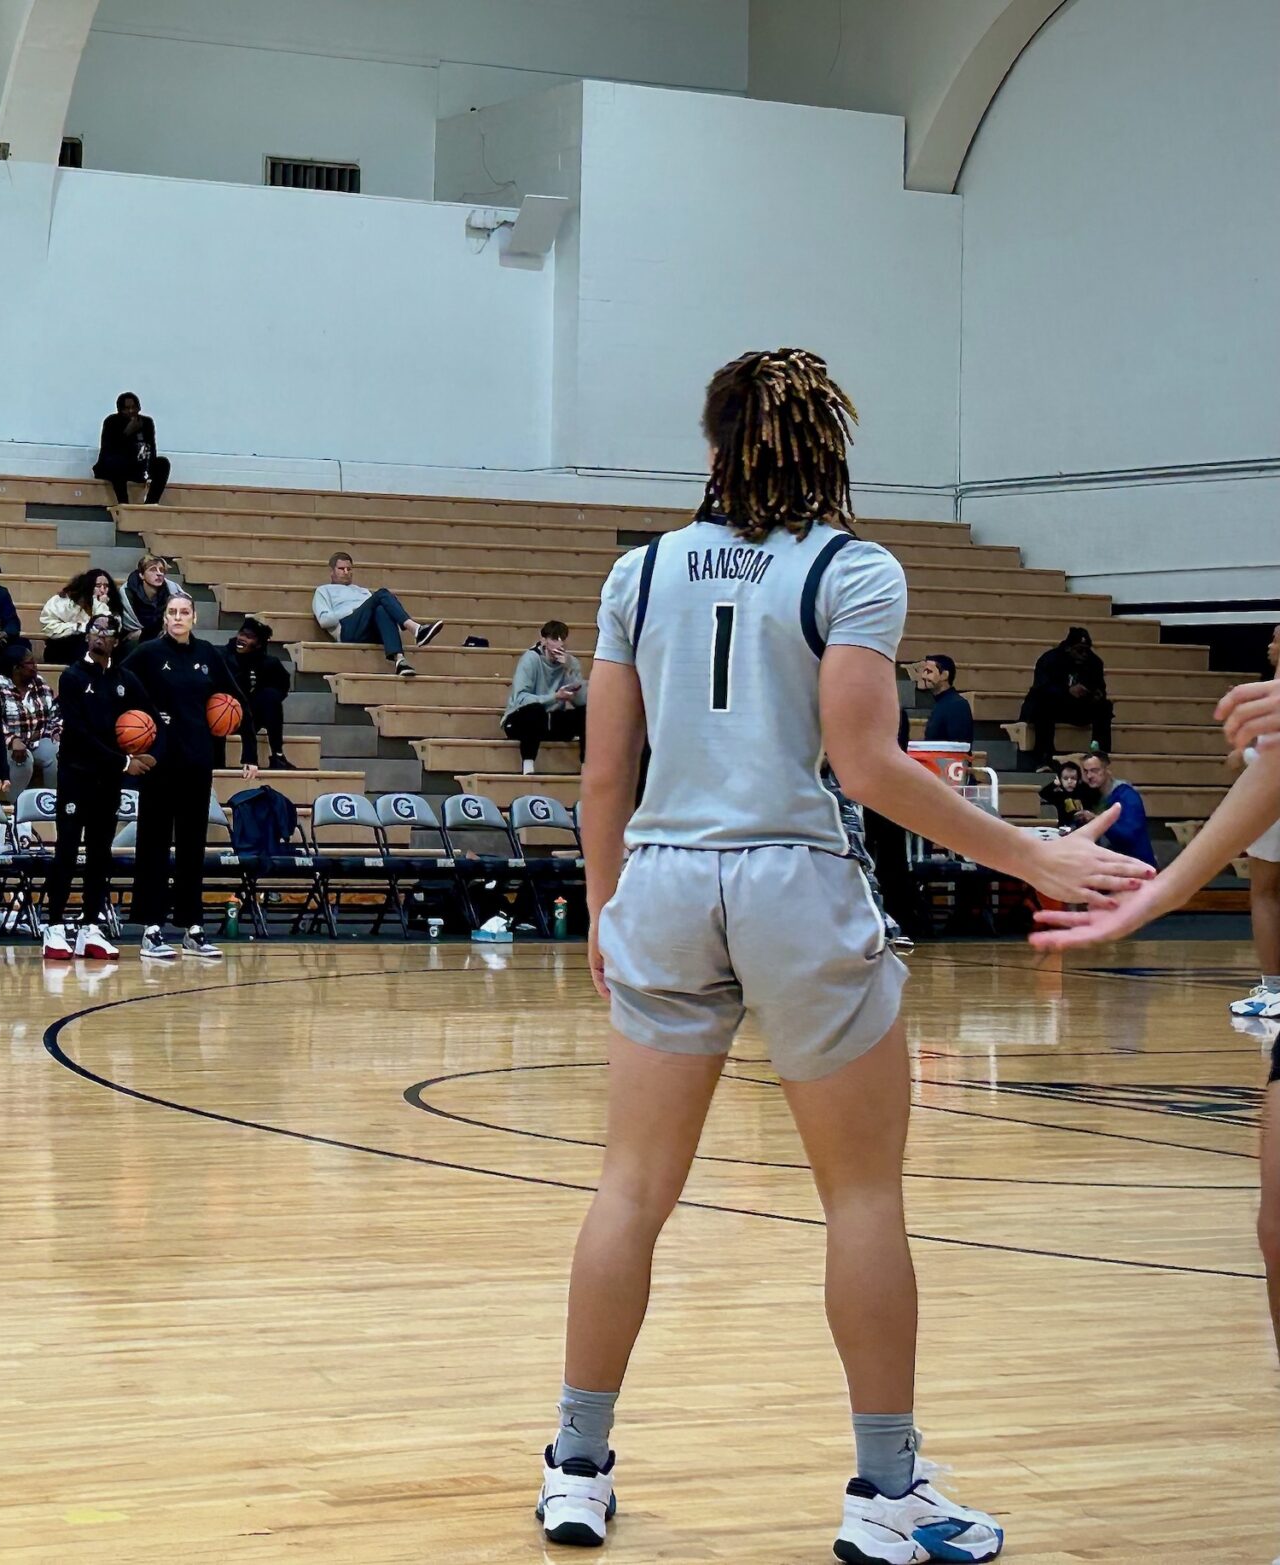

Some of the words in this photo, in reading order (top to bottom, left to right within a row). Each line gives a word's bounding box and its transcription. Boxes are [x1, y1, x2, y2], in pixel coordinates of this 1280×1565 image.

[687, 547, 774, 584] RANSOM
[710, 603, 736, 711] 1
[331, 794, 358, 820] G
[391, 796, 418, 820] G
[459, 795, 485, 820] G
[528, 797, 553, 821] G
